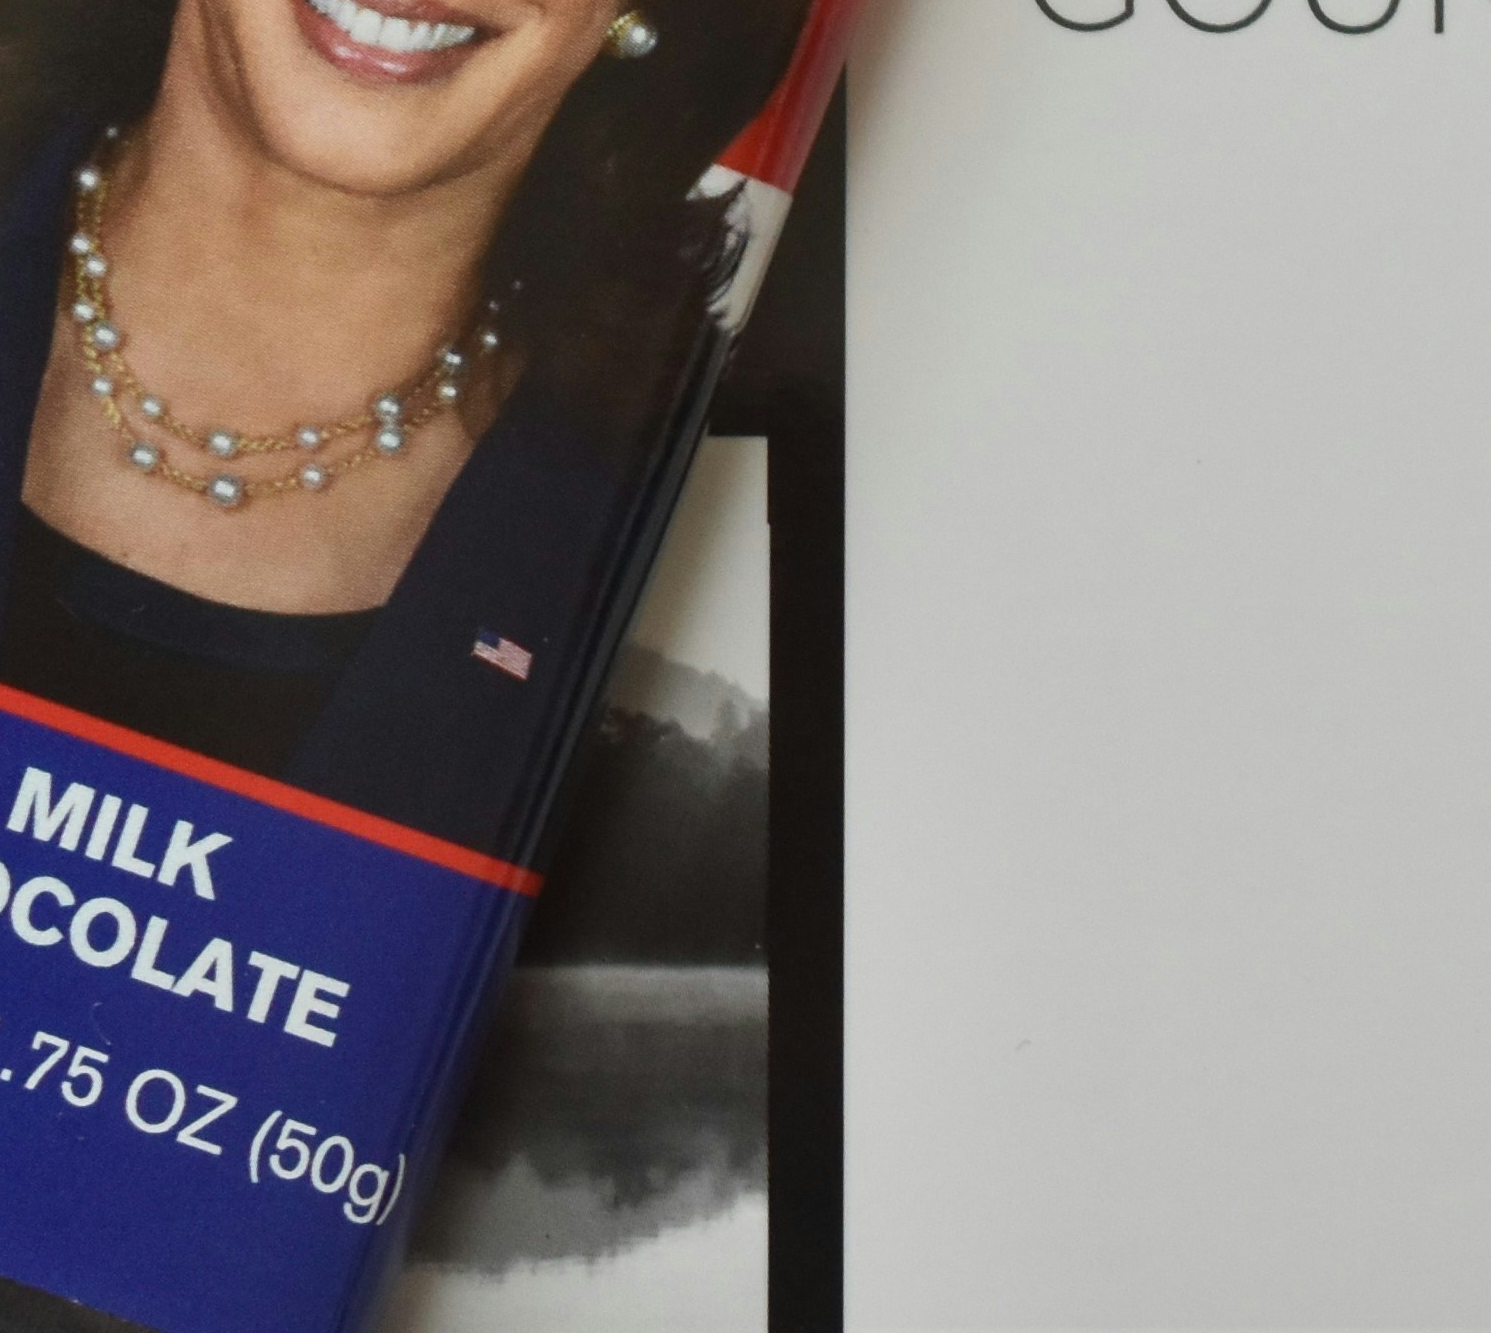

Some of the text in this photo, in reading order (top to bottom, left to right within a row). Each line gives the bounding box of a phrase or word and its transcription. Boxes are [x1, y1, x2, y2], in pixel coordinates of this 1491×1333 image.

[7, 767, 232, 900] MILK
[126, 1069, 237, 1155] OZ
[250, 1111, 404, 1224] (50g)
